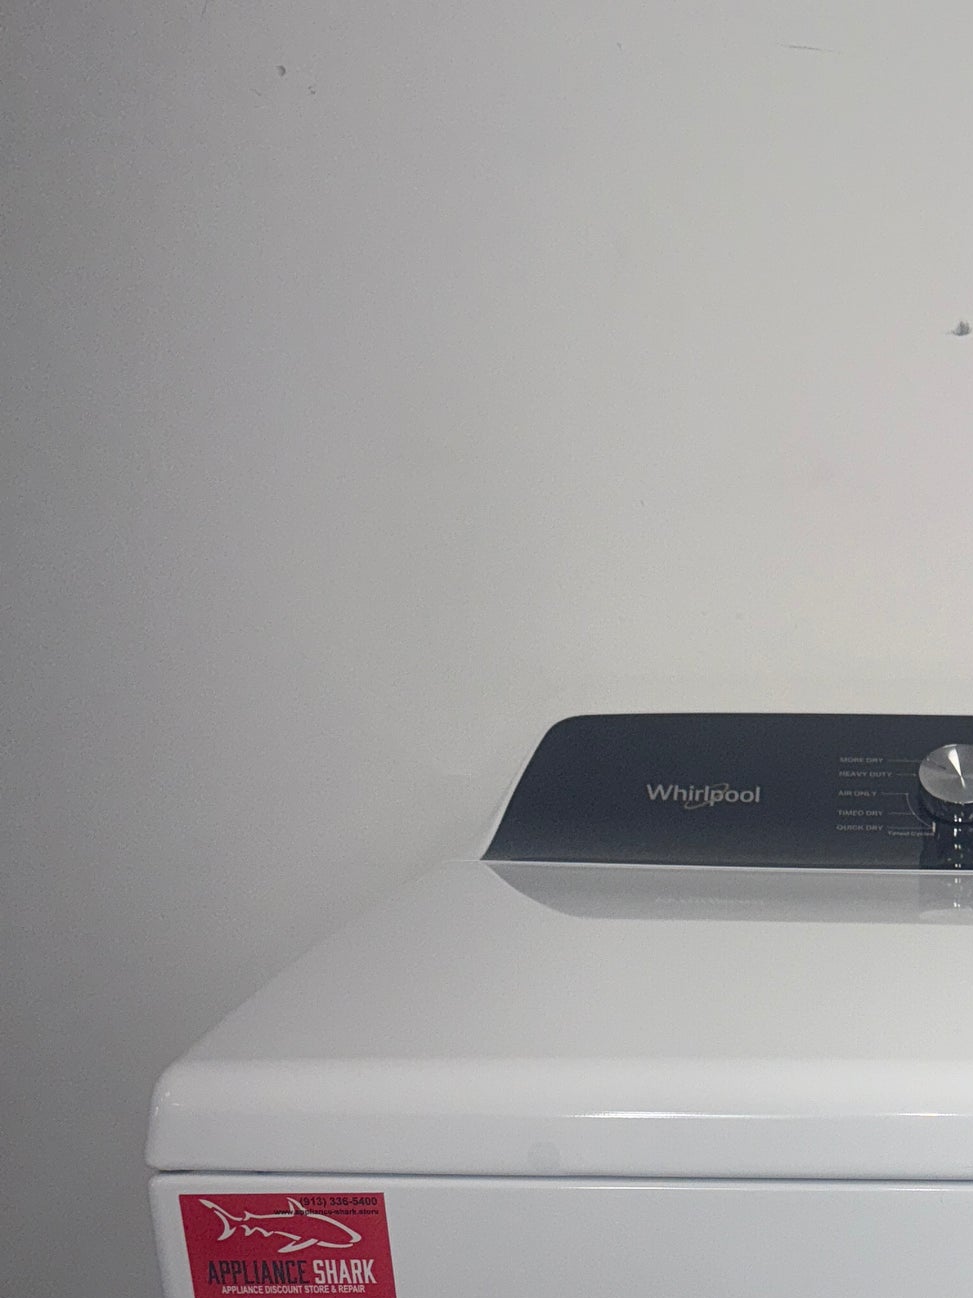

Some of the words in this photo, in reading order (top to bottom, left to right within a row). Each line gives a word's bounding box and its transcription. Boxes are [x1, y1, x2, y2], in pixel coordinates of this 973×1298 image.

[646, 784, 761, 808] Whirlpool
[299, 1197, 327, 1208] (913)
[330, 1197, 378, 1206] 336-5400
[208, 1260, 311, 1285] APPLIANCE
[313, 1259, 378, 1284] SHARK
[222, 1285, 264, 1294] APPLIANCE
[265, 1285, 302, 1294] DISCOUNT
[304, 1285, 330, 1294] STORE
[331, 1285, 337, 1294] &
[338, 1285, 366, 1294] REPAIR
